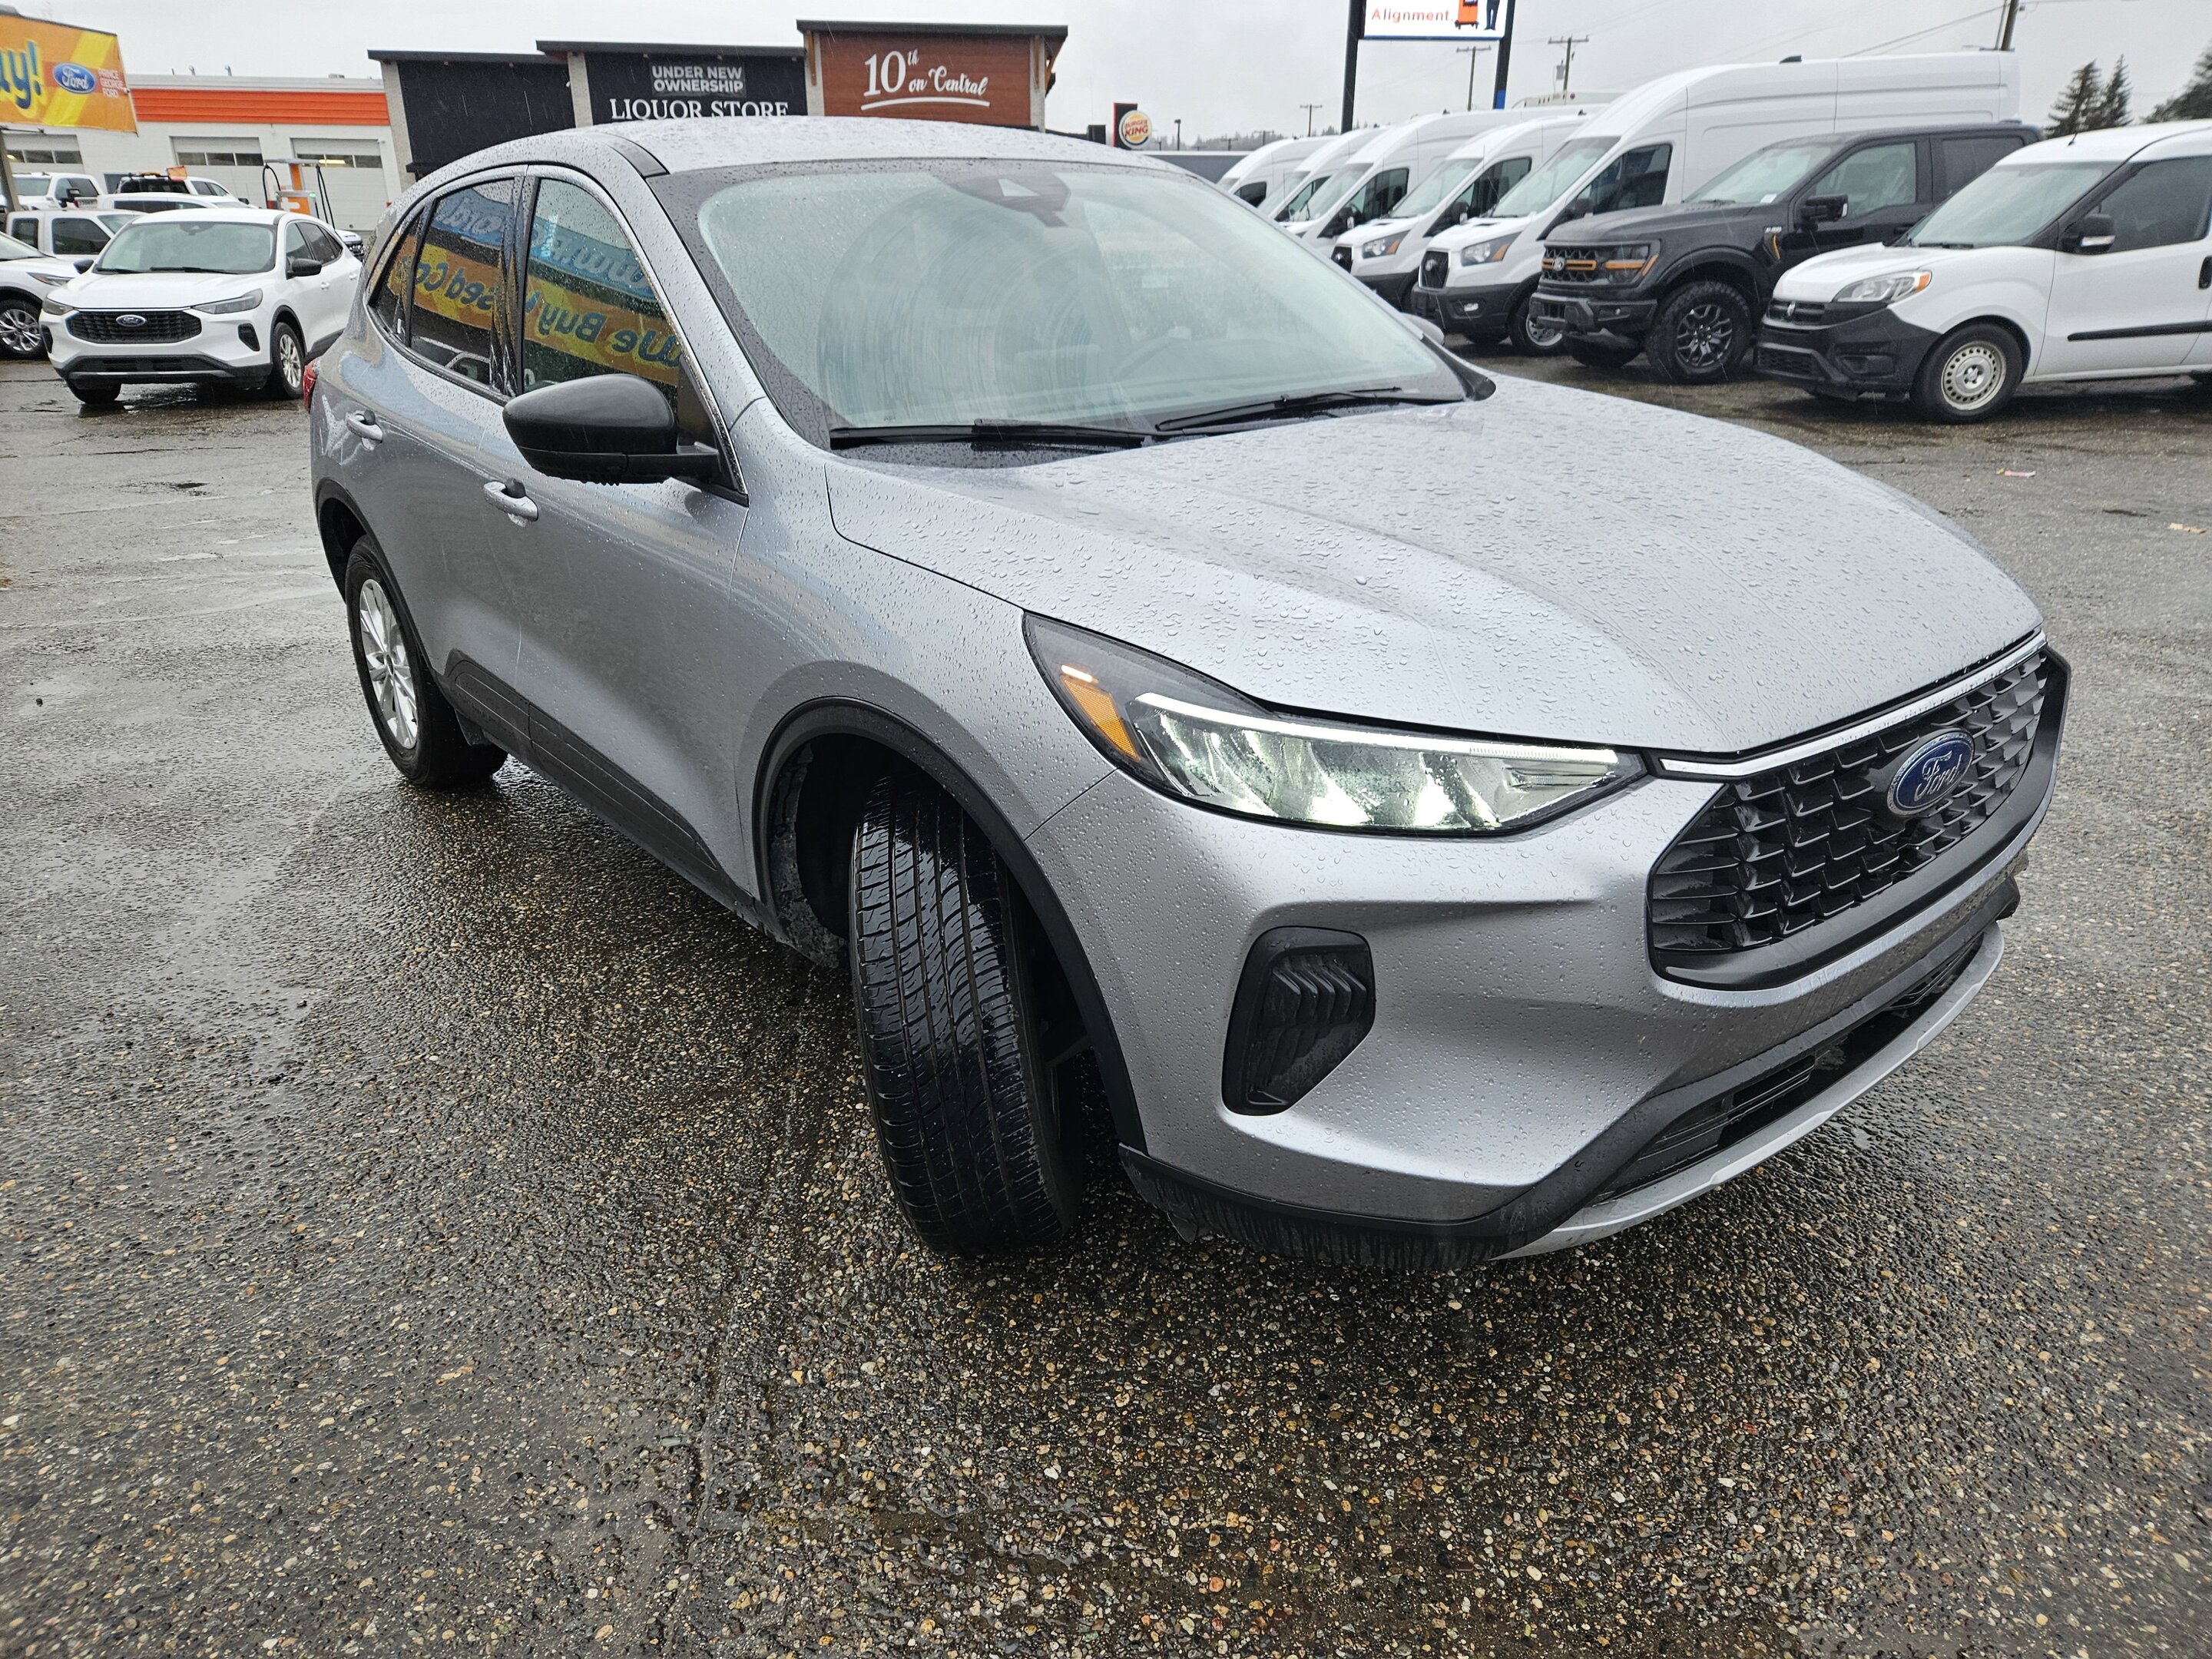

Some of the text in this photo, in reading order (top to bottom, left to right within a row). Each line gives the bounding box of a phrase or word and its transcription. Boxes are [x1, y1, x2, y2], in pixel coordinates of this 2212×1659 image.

[61, 66, 90, 90] Ford
[652, 66, 743, 79] UNDER NEW
[100, 78, 124, 90] GEORGE
[654, 80, 743, 93] OWNERSHIP
[909, 78, 928, 93] on
[928, 65, 989, 96] Central
[102, 88, 118, 98] FORD
[609, 98, 788, 120] LIQUOR STORE
[1124, 126, 1148, 138] KING
[1913, 750, 1963, 802] Ford
